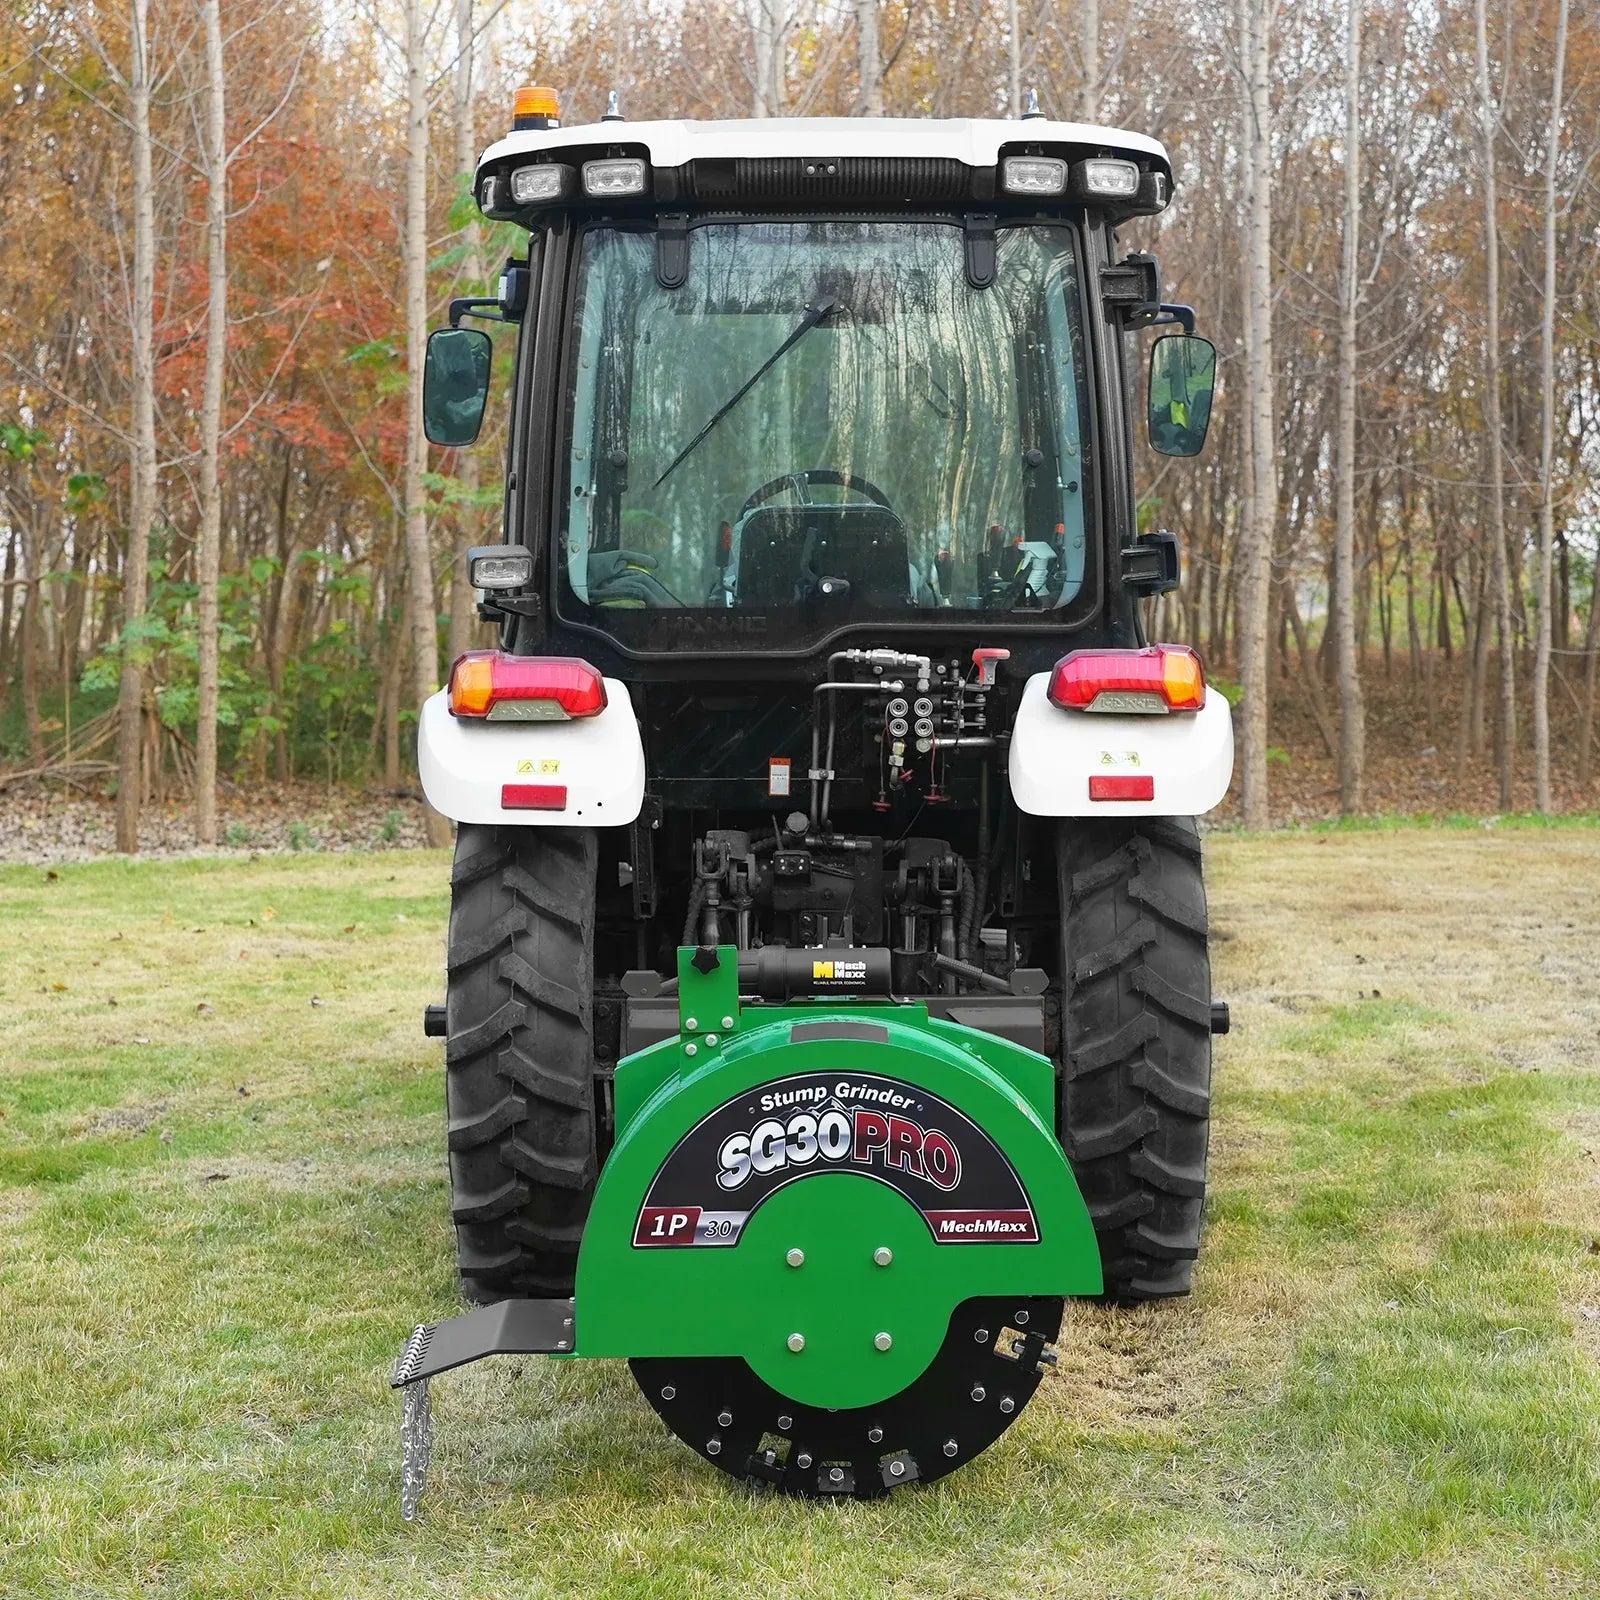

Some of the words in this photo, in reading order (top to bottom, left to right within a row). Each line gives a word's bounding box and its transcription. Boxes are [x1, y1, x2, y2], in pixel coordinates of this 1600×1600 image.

[835, 970, 866, 978] Maxx
[761, 1086, 828, 1111] Stump
[835, 1082, 916, 1110] Grinder
[717, 1109, 962, 1191] SG30PRO
[651, 1214, 688, 1236] 1P
[704, 1220, 733, 1237] 30
[939, 1219, 1028, 1235] MechMaxx
